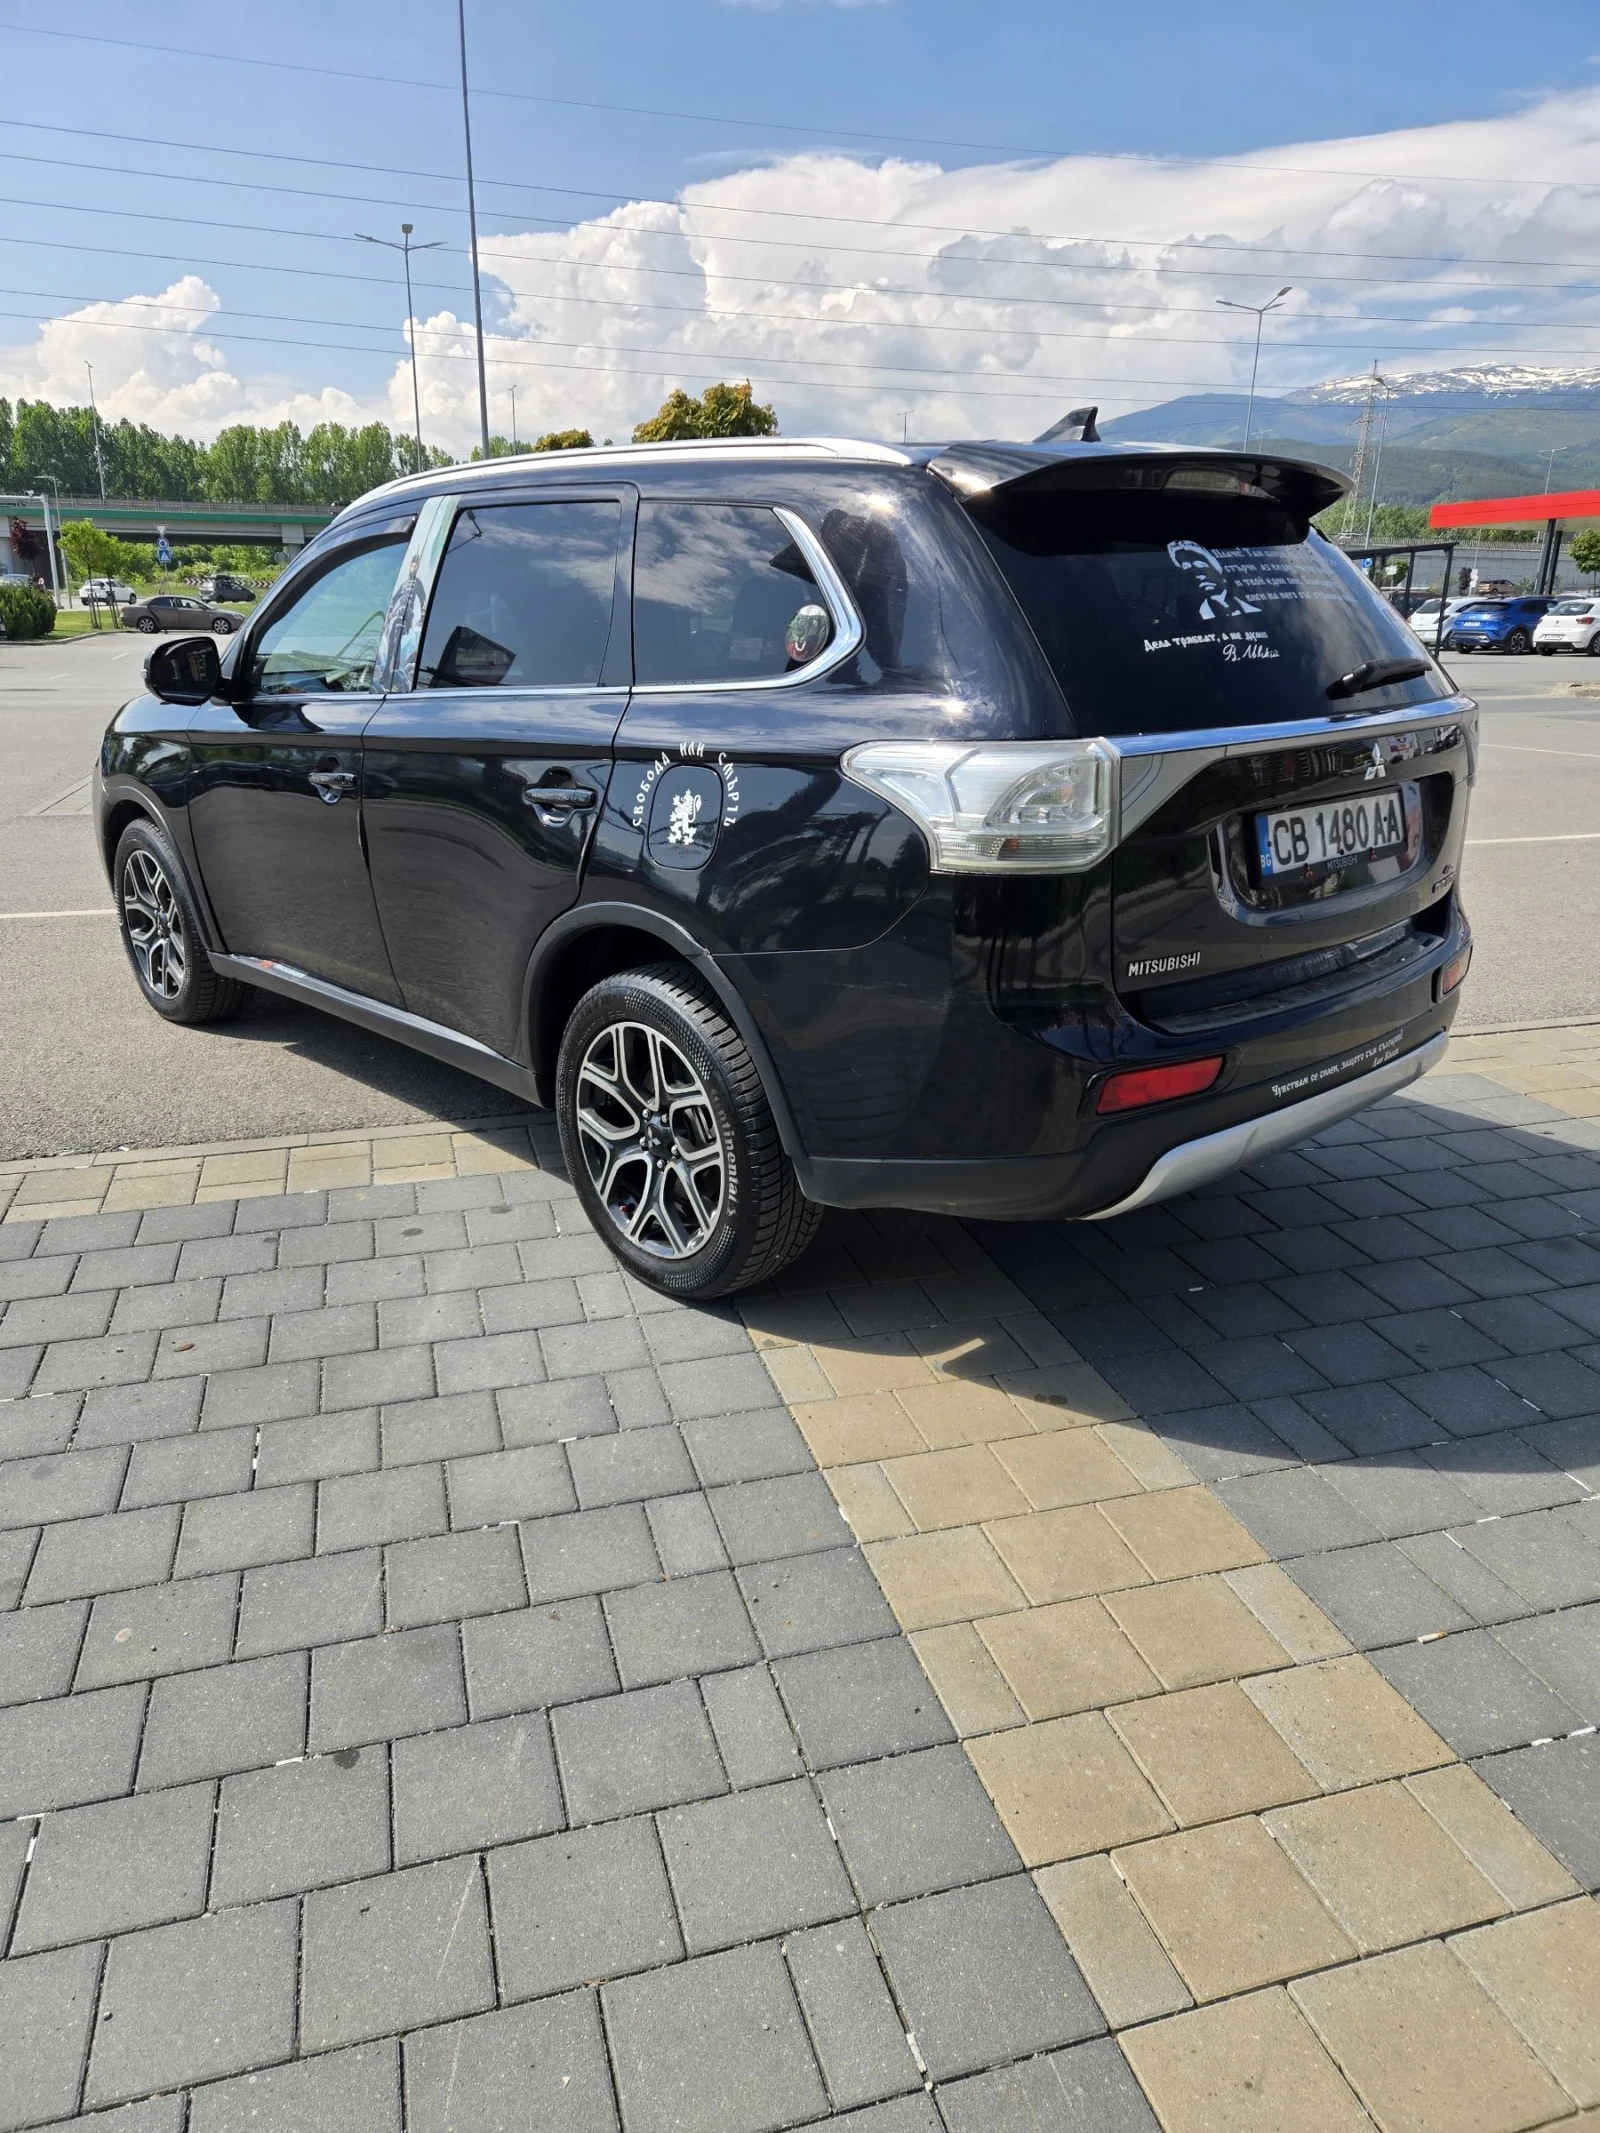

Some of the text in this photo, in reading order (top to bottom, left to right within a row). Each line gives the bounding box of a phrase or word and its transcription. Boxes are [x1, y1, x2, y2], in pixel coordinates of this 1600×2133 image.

[1143, 639, 1172, 652] Дела
[632, 751, 671, 828] СВОБОДА
[679, 741, 706, 758] ИЛИ
[1273, 799, 1401, 866] CB 1480 AA
[1260, 854, 1272, 868] BG
[1326, 854, 1359, 872] MITSUBISHI
[1128, 951, 1201, 977] MITSUBISHI
[711, 1088, 741, 1204] Continental
